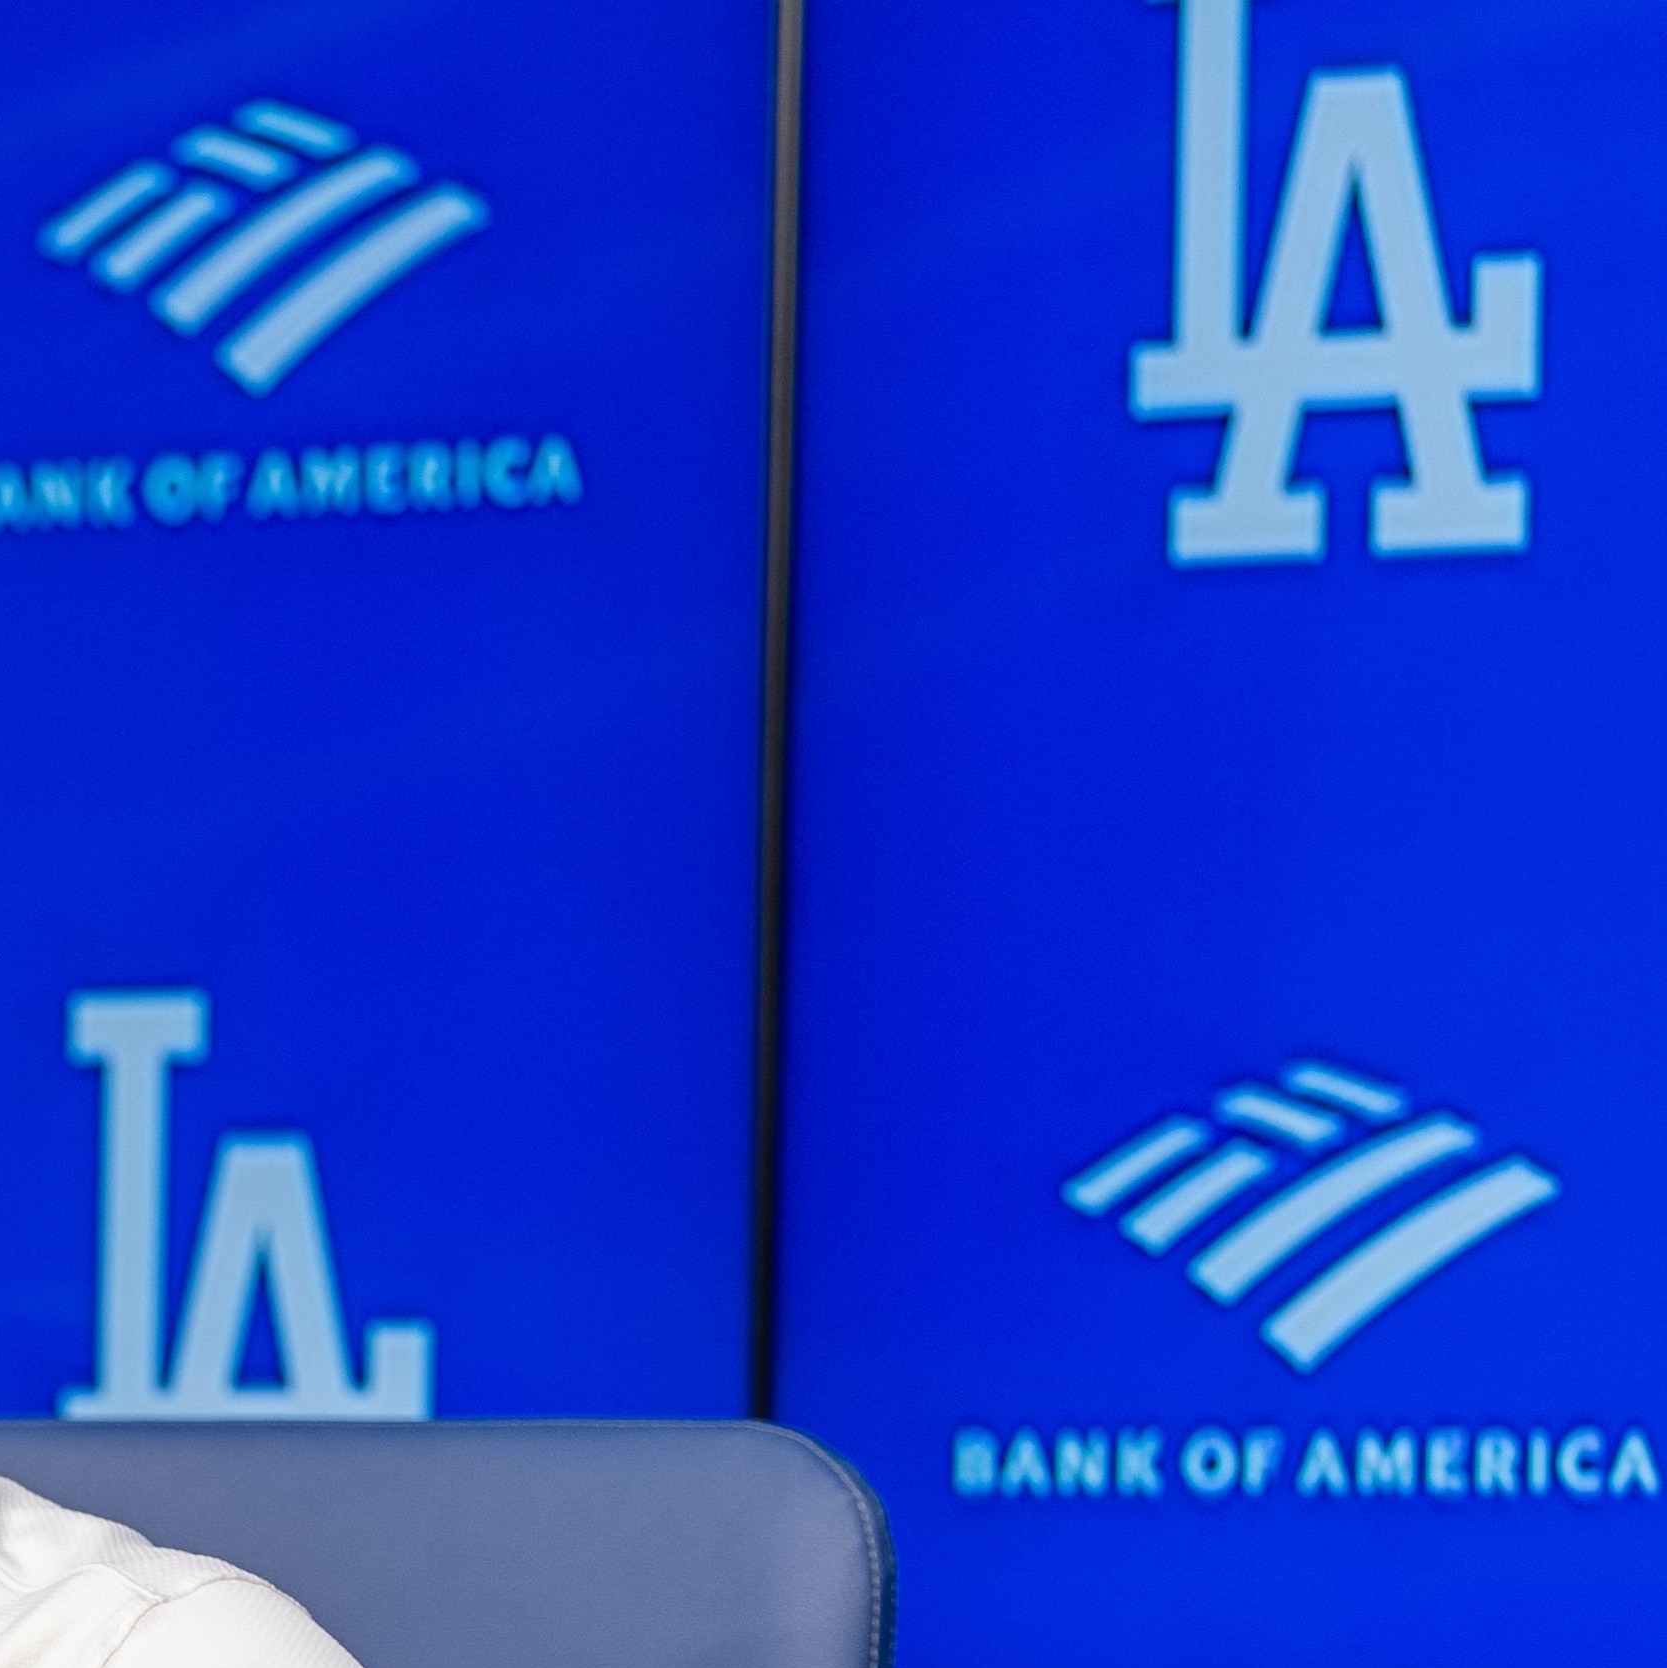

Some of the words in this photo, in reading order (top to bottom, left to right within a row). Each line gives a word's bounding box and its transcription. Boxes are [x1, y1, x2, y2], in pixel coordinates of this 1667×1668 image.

[1130, 0, 1543, 567] LA
[141, 453, 244, 526] OF
[248, 434, 581, 520] AMERICA
[59, 989, 434, 1421] LA
[953, 1425, 1162, 1497] BANK
[1179, 1425, 1283, 1498] OF
[1296, 1424, 1659, 1498] AMERICA
